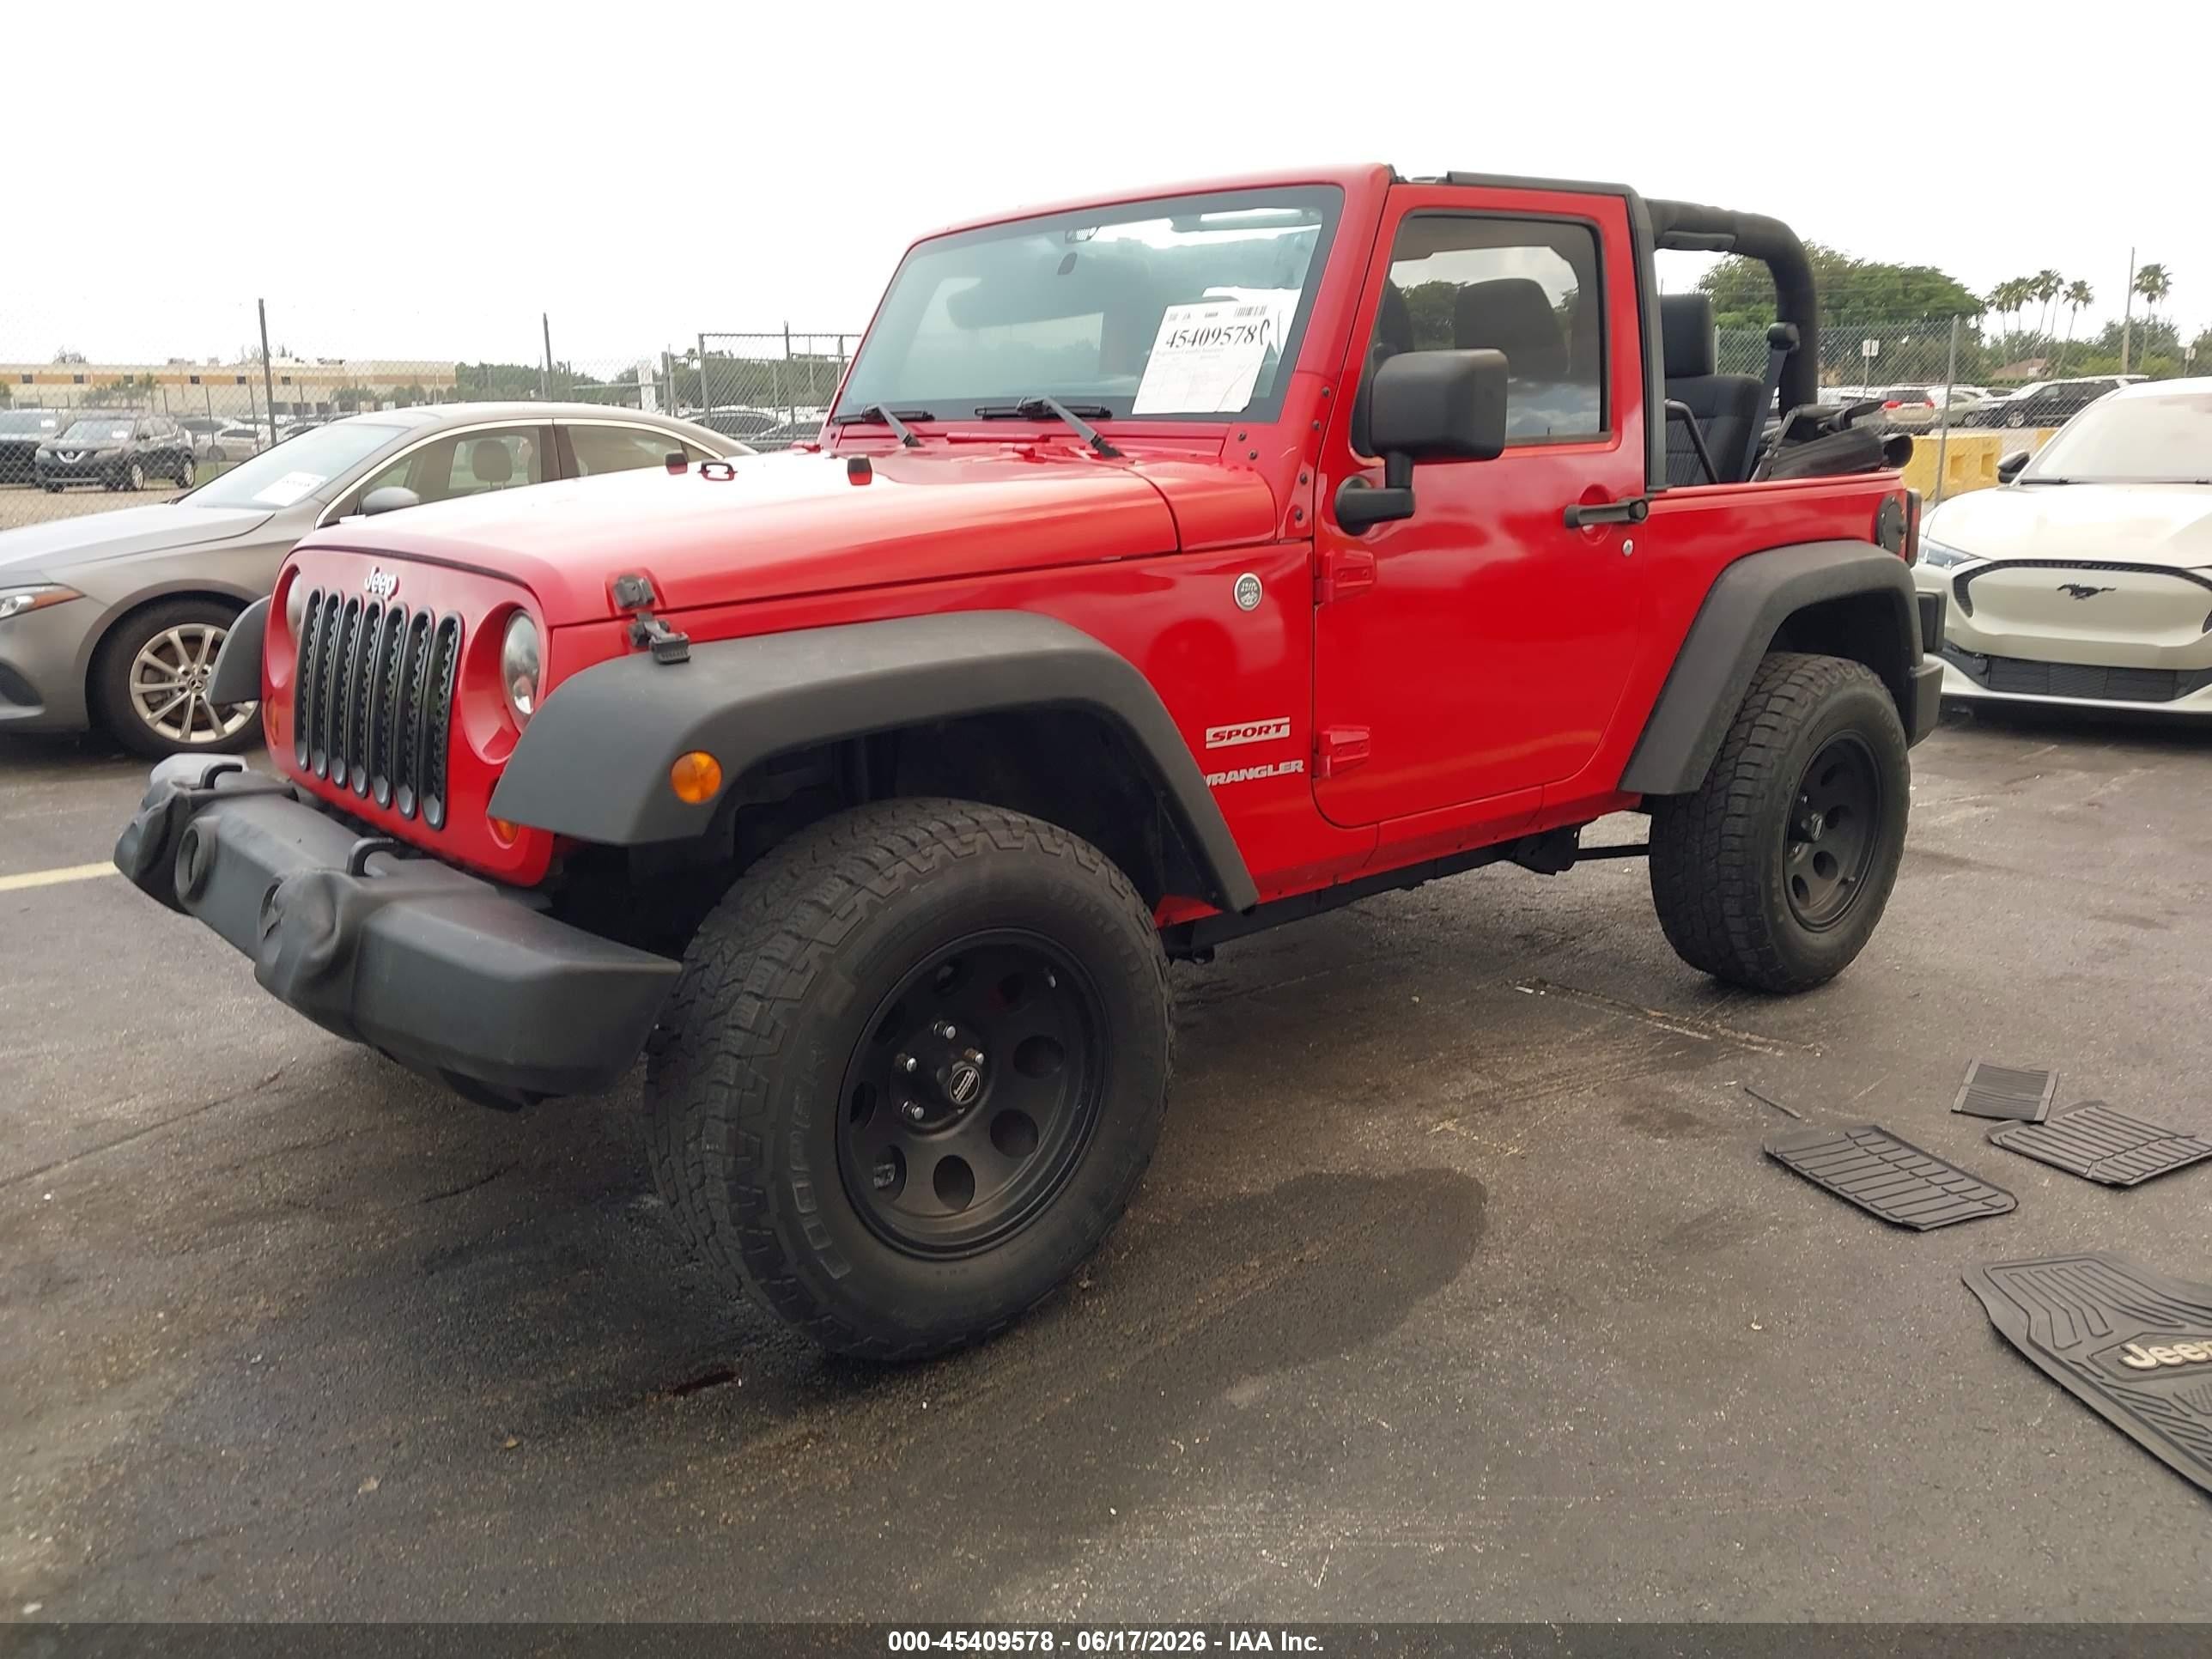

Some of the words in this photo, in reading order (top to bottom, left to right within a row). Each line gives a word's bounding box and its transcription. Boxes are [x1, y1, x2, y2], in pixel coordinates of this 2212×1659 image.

[1165, 324, 1257, 349] 45409578
[364, 566, 398, 600] Jeep
[1212, 723, 1286, 742] SPORT
